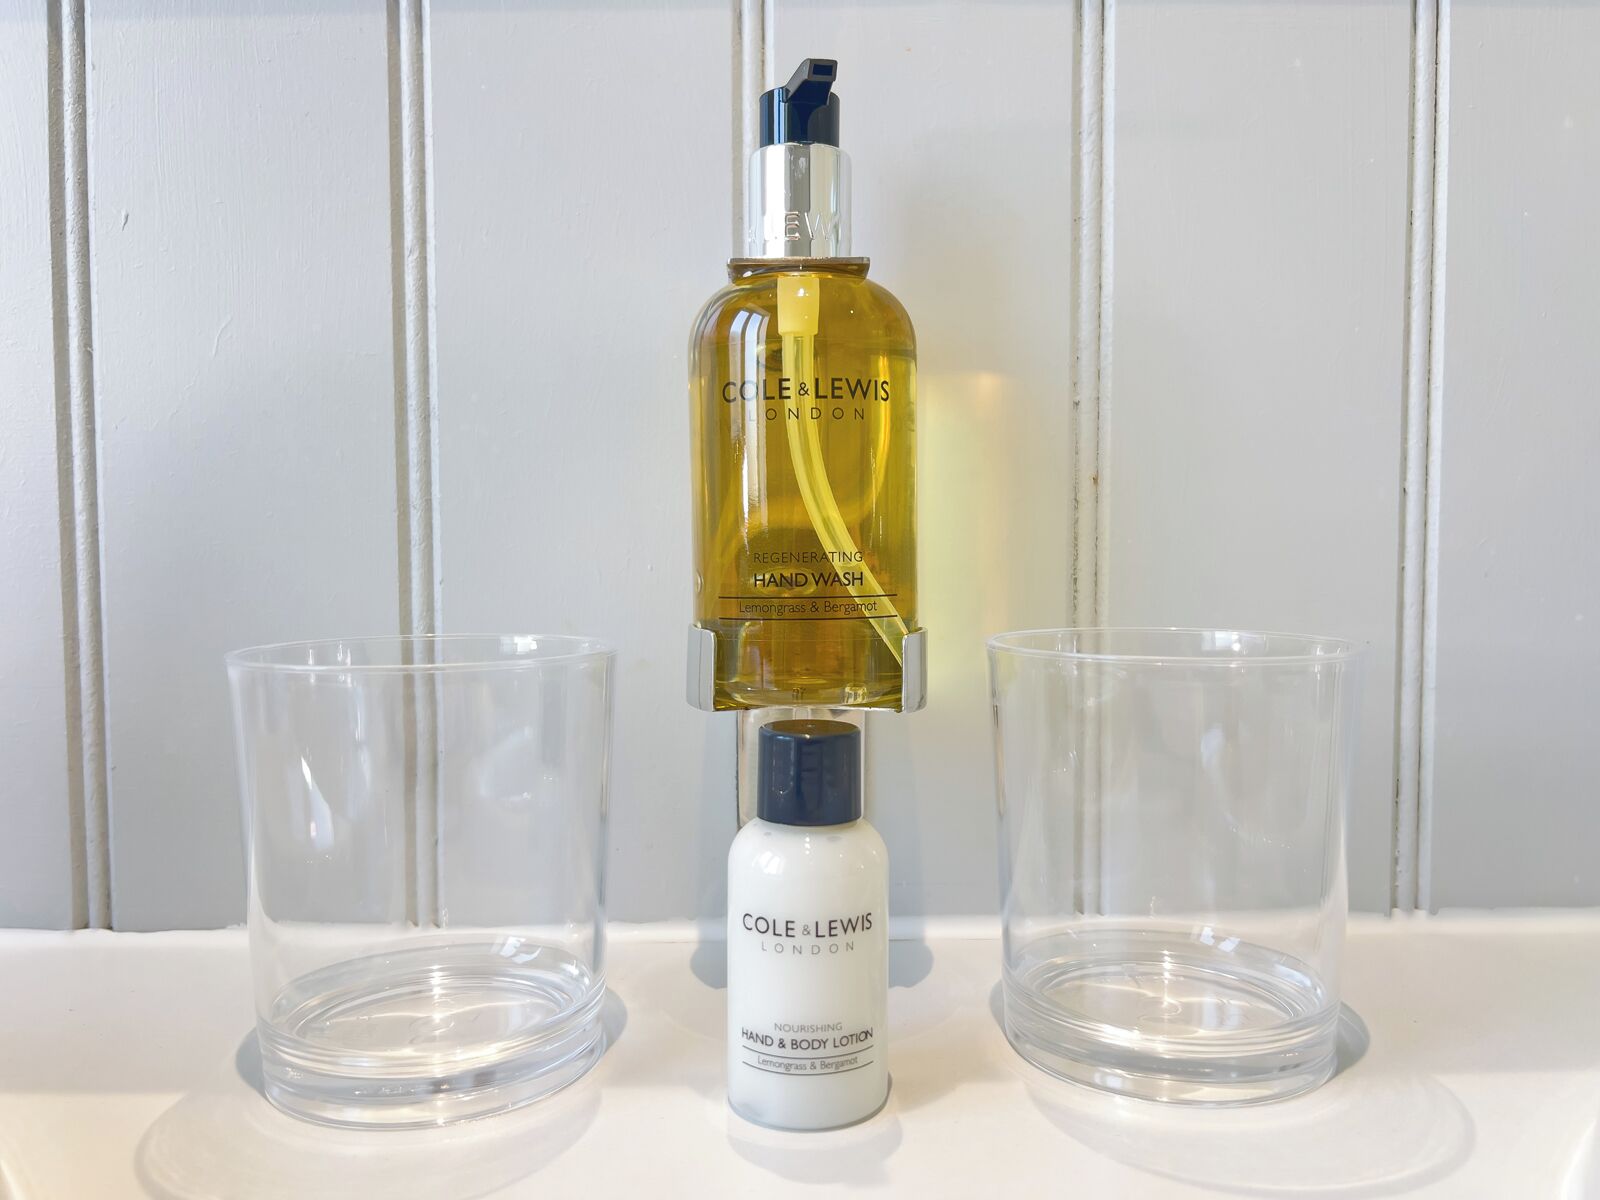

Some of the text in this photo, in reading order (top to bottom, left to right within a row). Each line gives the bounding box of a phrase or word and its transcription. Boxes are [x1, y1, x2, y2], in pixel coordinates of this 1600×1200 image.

[722, 377, 890, 403] COLE & LEWIS
[749, 407, 865, 422] LONDON
[753, 551, 863, 564] REGENERATING
[753, 571, 864, 588] HAND WASH
[739, 601, 878, 616] Lemongrass & Bergamot
[742, 912, 873, 938] COLE & LEWIS
[761, 940, 854, 956] LONDON
[774, 1022, 843, 1033] NOURISHING
[741, 1027, 874, 1051] HAND & BODY LOTION
[757, 1055, 858, 1072] Lemongrass & Bergamot
